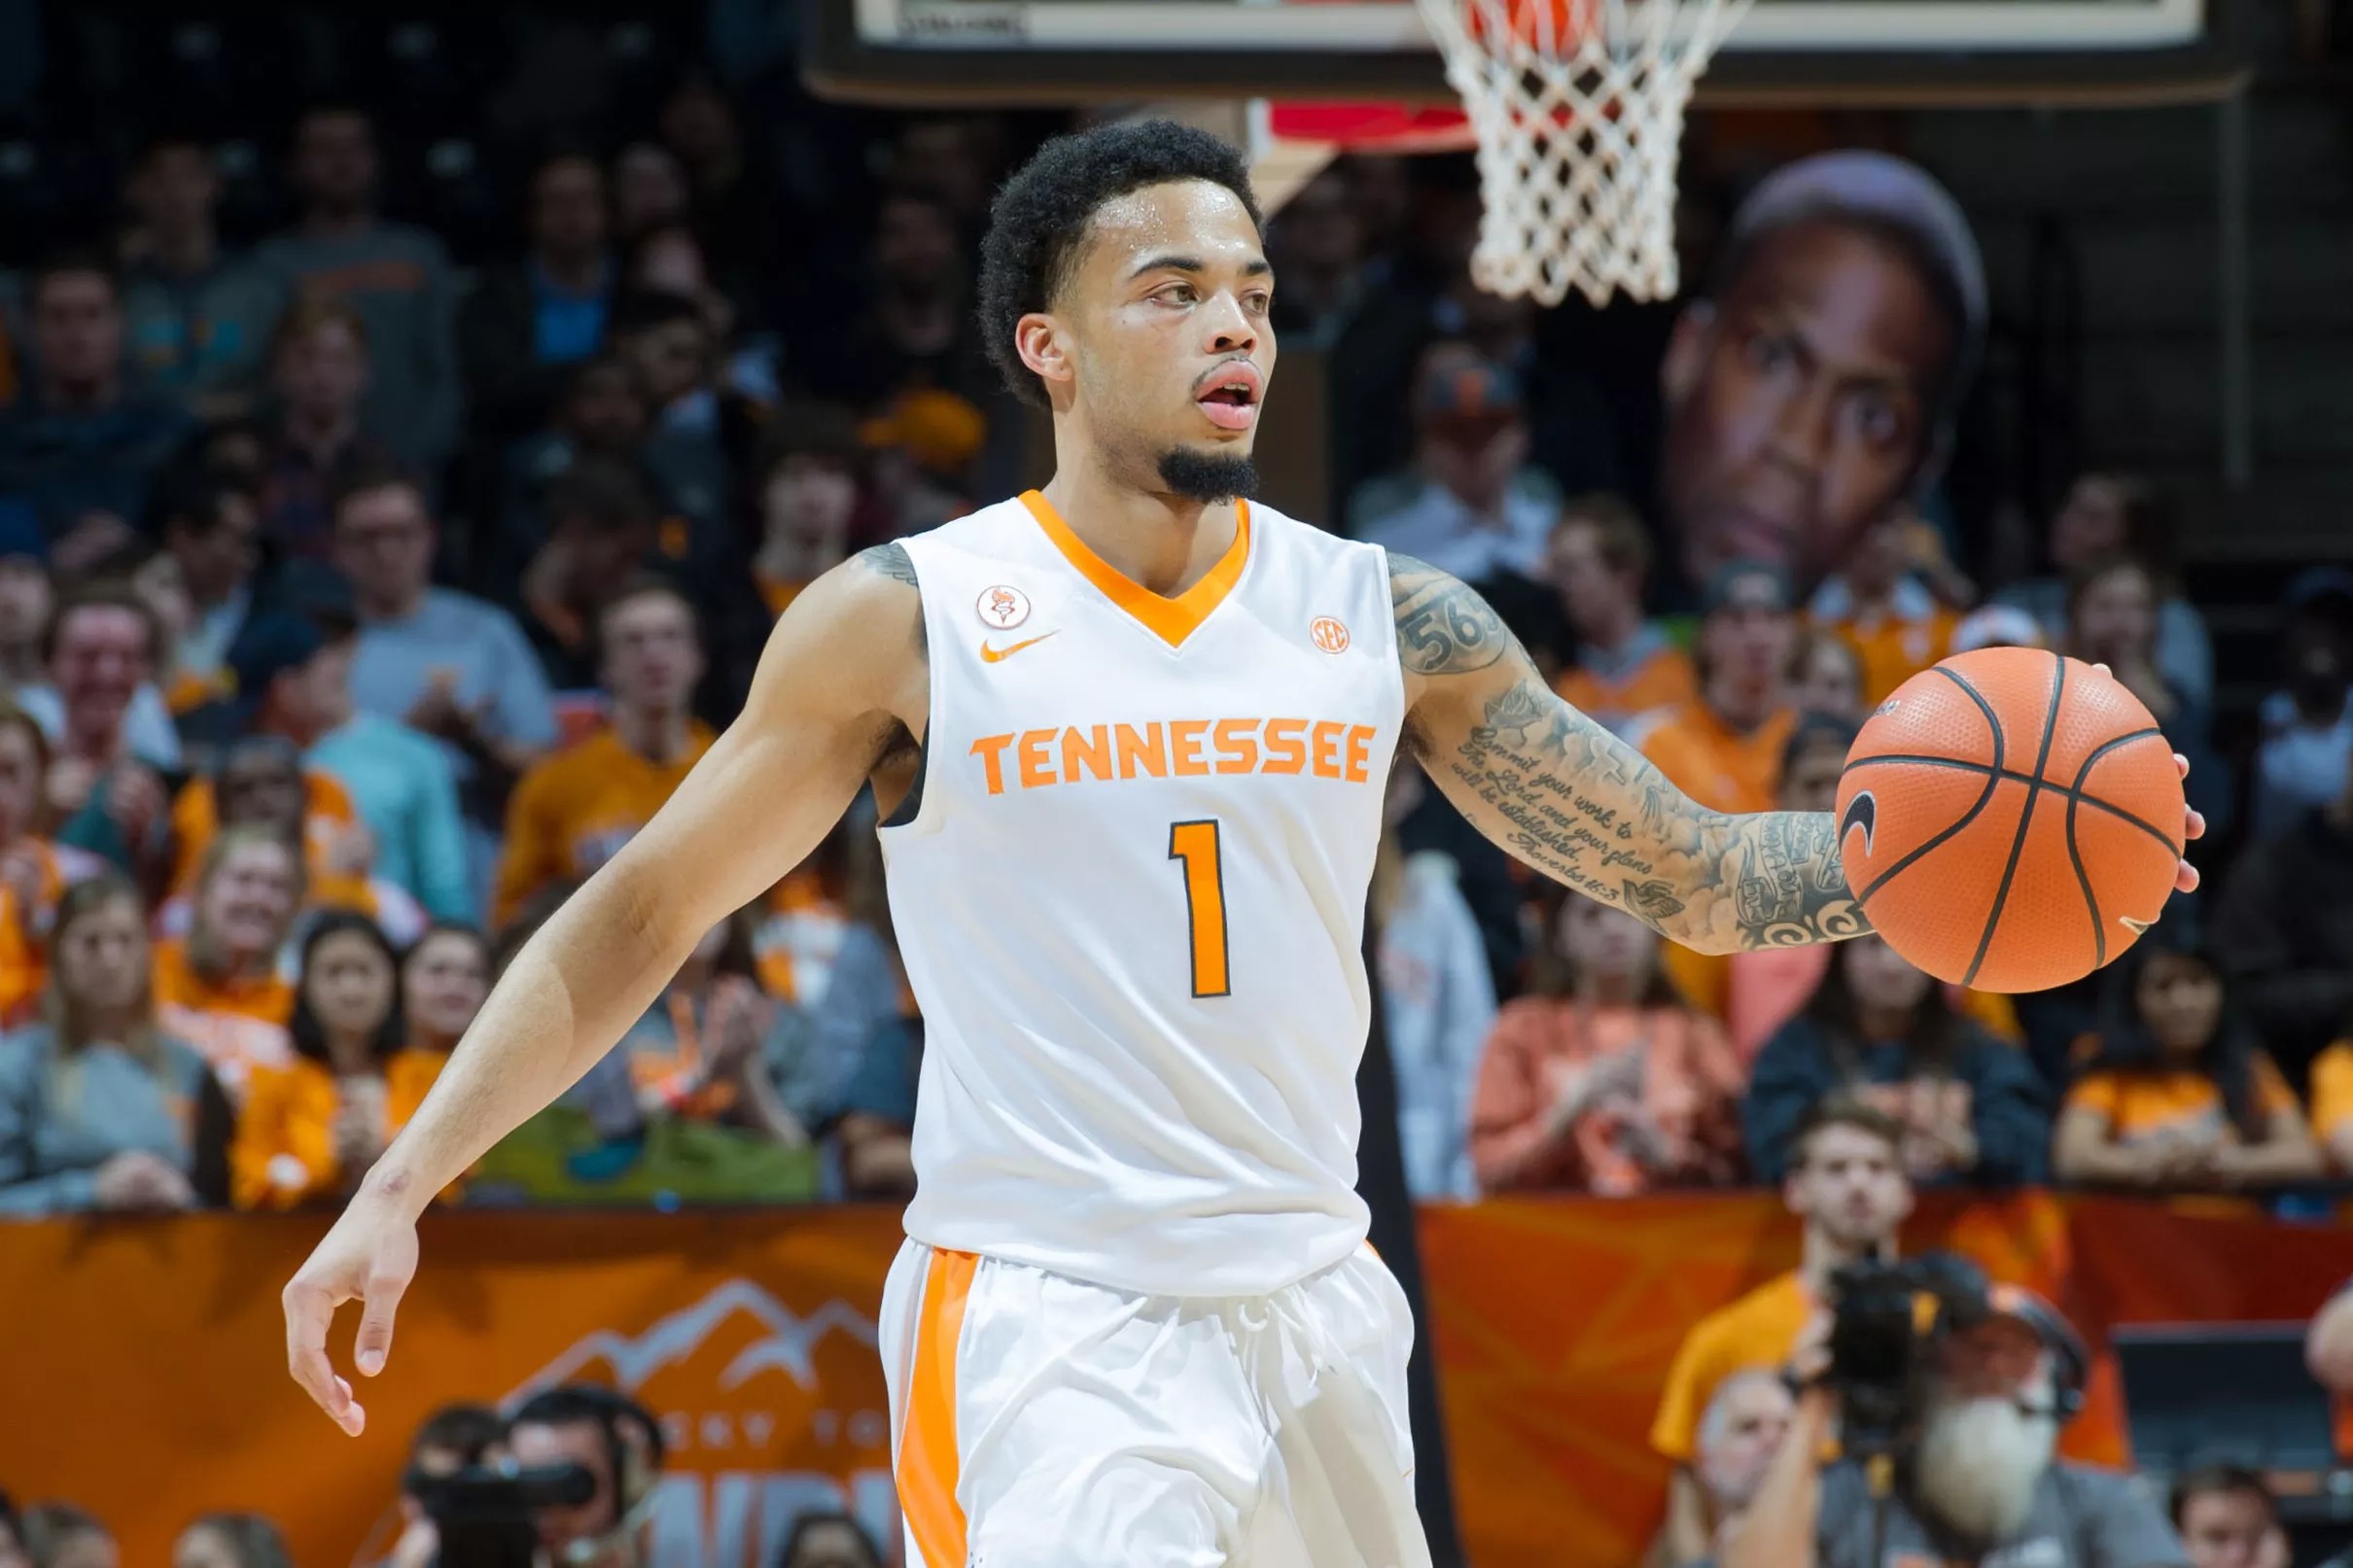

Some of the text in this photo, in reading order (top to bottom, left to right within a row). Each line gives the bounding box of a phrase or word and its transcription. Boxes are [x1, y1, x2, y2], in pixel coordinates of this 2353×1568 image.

[1314, 619, 1347, 651] SEC
[969, 718, 1377, 795] TENNESSEE
[1452, 762, 1484, 788] will
[1479, 785, 1497, 804] be
[1470, 726, 1632, 839] Commit your work to
[1539, 805, 1578, 829] and
[1563, 828, 1609, 854] your
[1601, 850, 1653, 875] plans
[1169, 819, 1231, 998] 1
